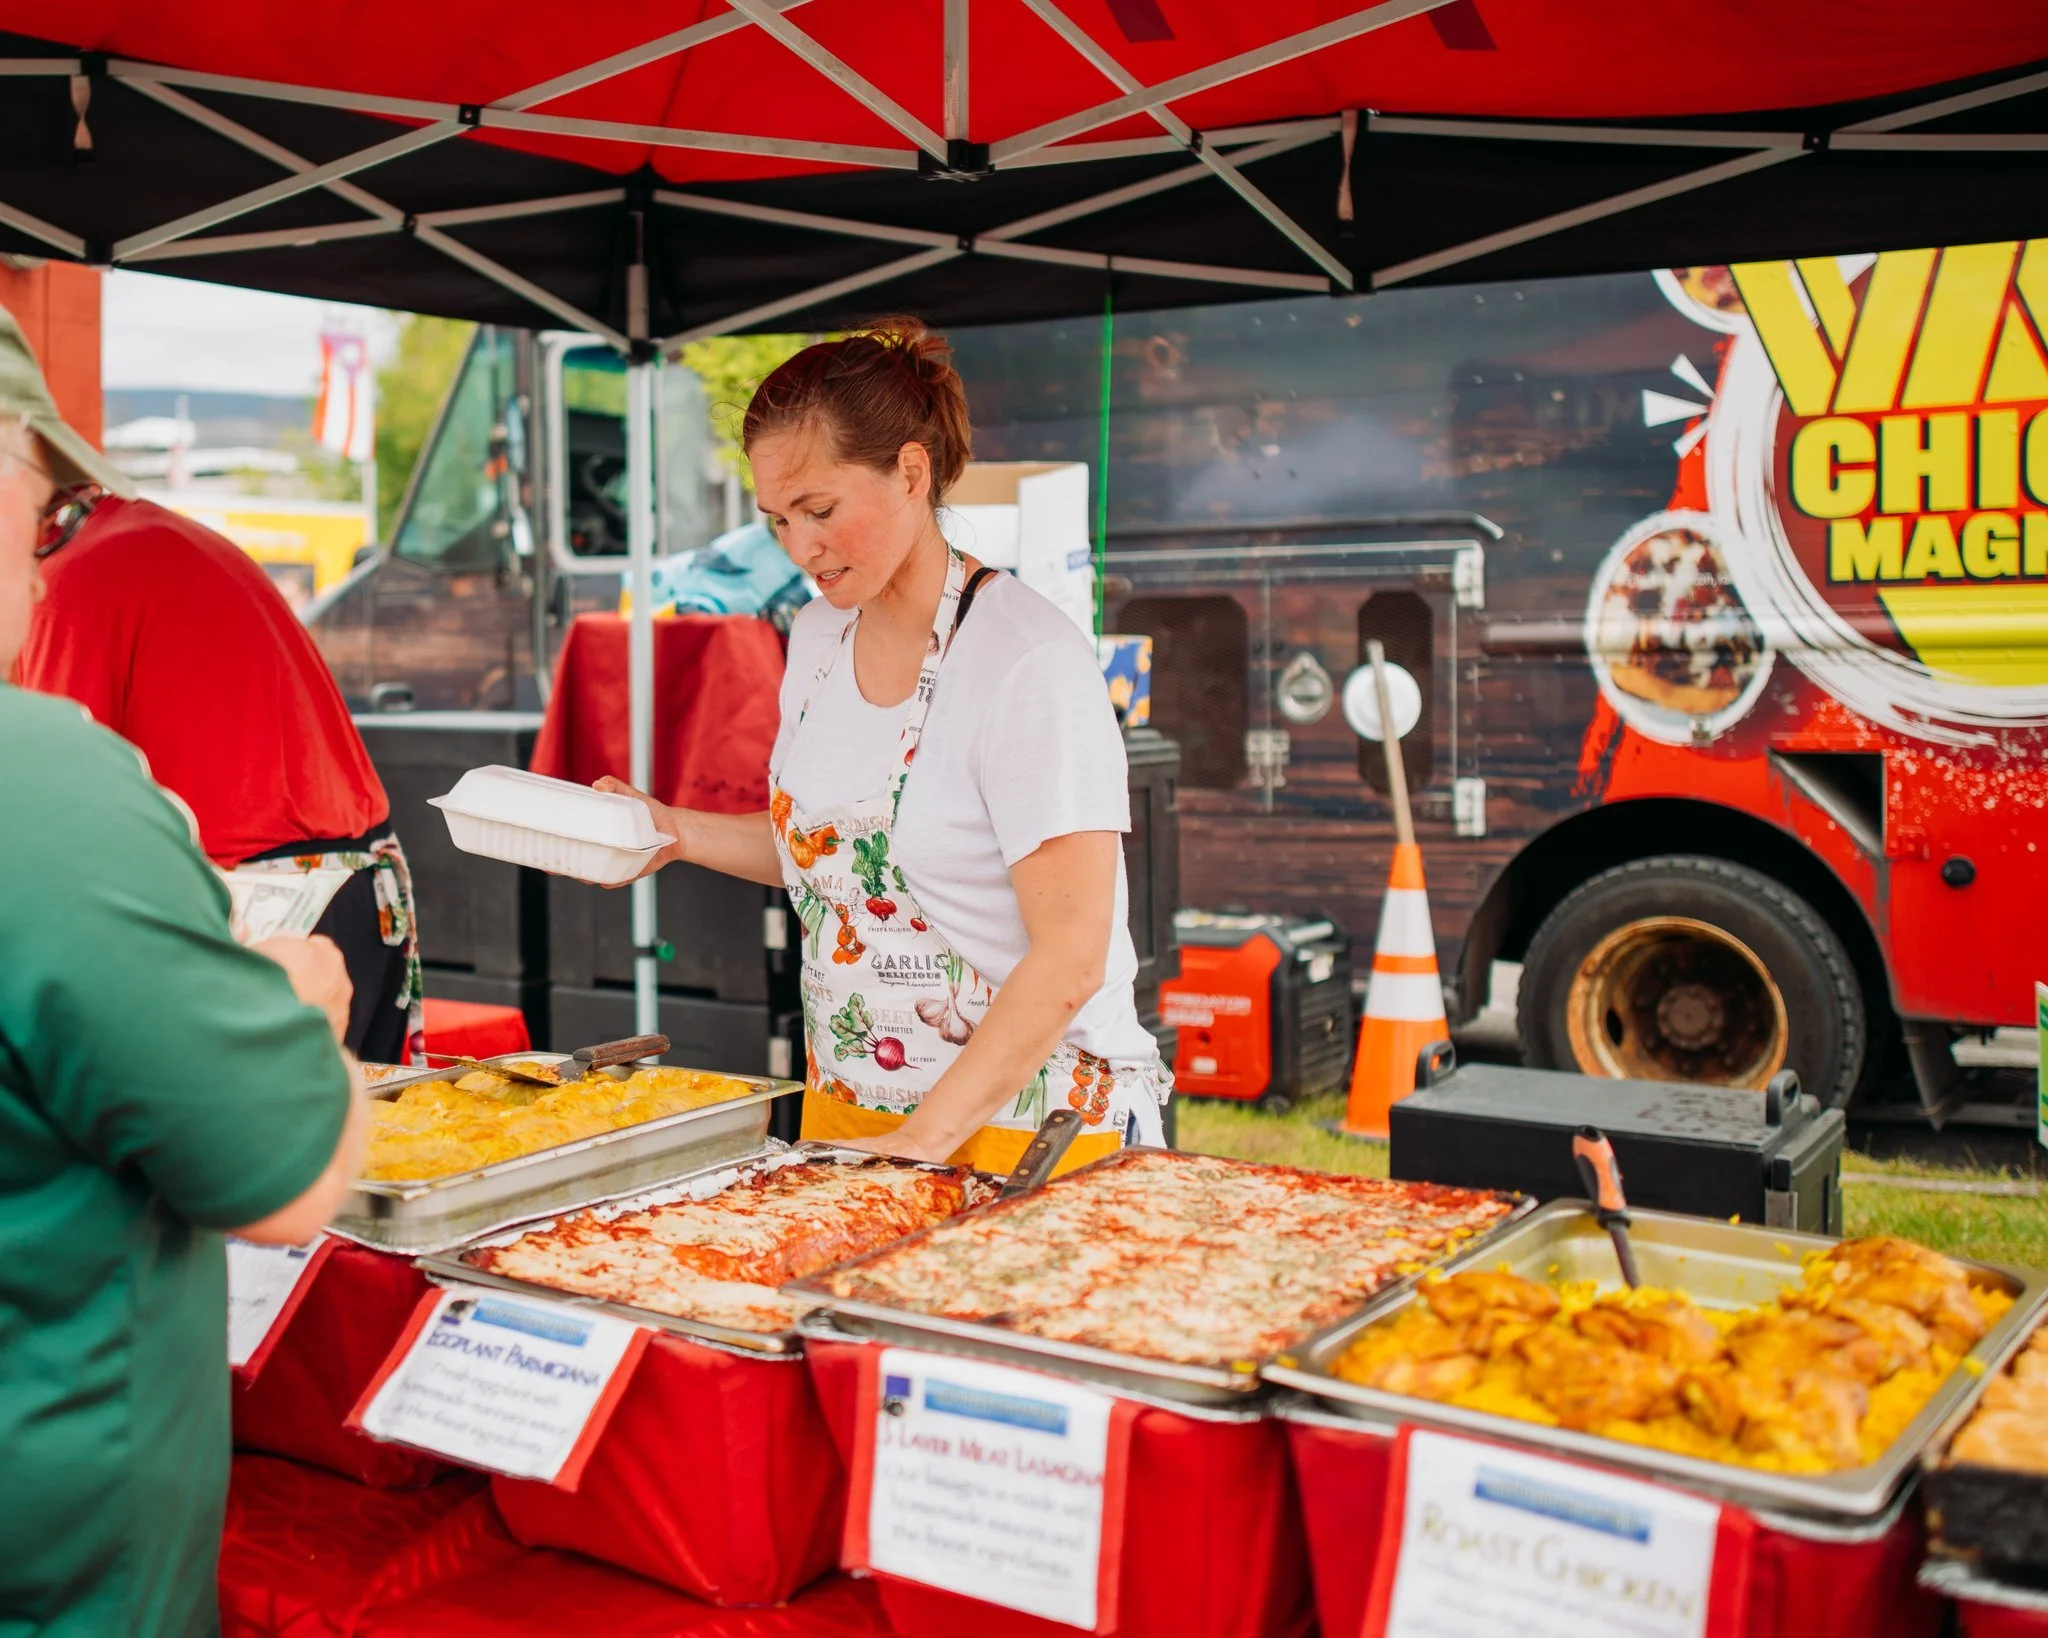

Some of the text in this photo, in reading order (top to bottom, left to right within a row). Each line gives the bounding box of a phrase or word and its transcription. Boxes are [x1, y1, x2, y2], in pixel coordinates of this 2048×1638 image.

[1790, 405, 2048, 520] CHI
[1828, 511, 2048, 583] MAG
[870, 952, 950, 971] GARLIC
[877, 970, 941, 980] DELICIOUS
[869, 1006, 916, 1025] BEET
[884, 1025, 914, 1034] VARIETIES
